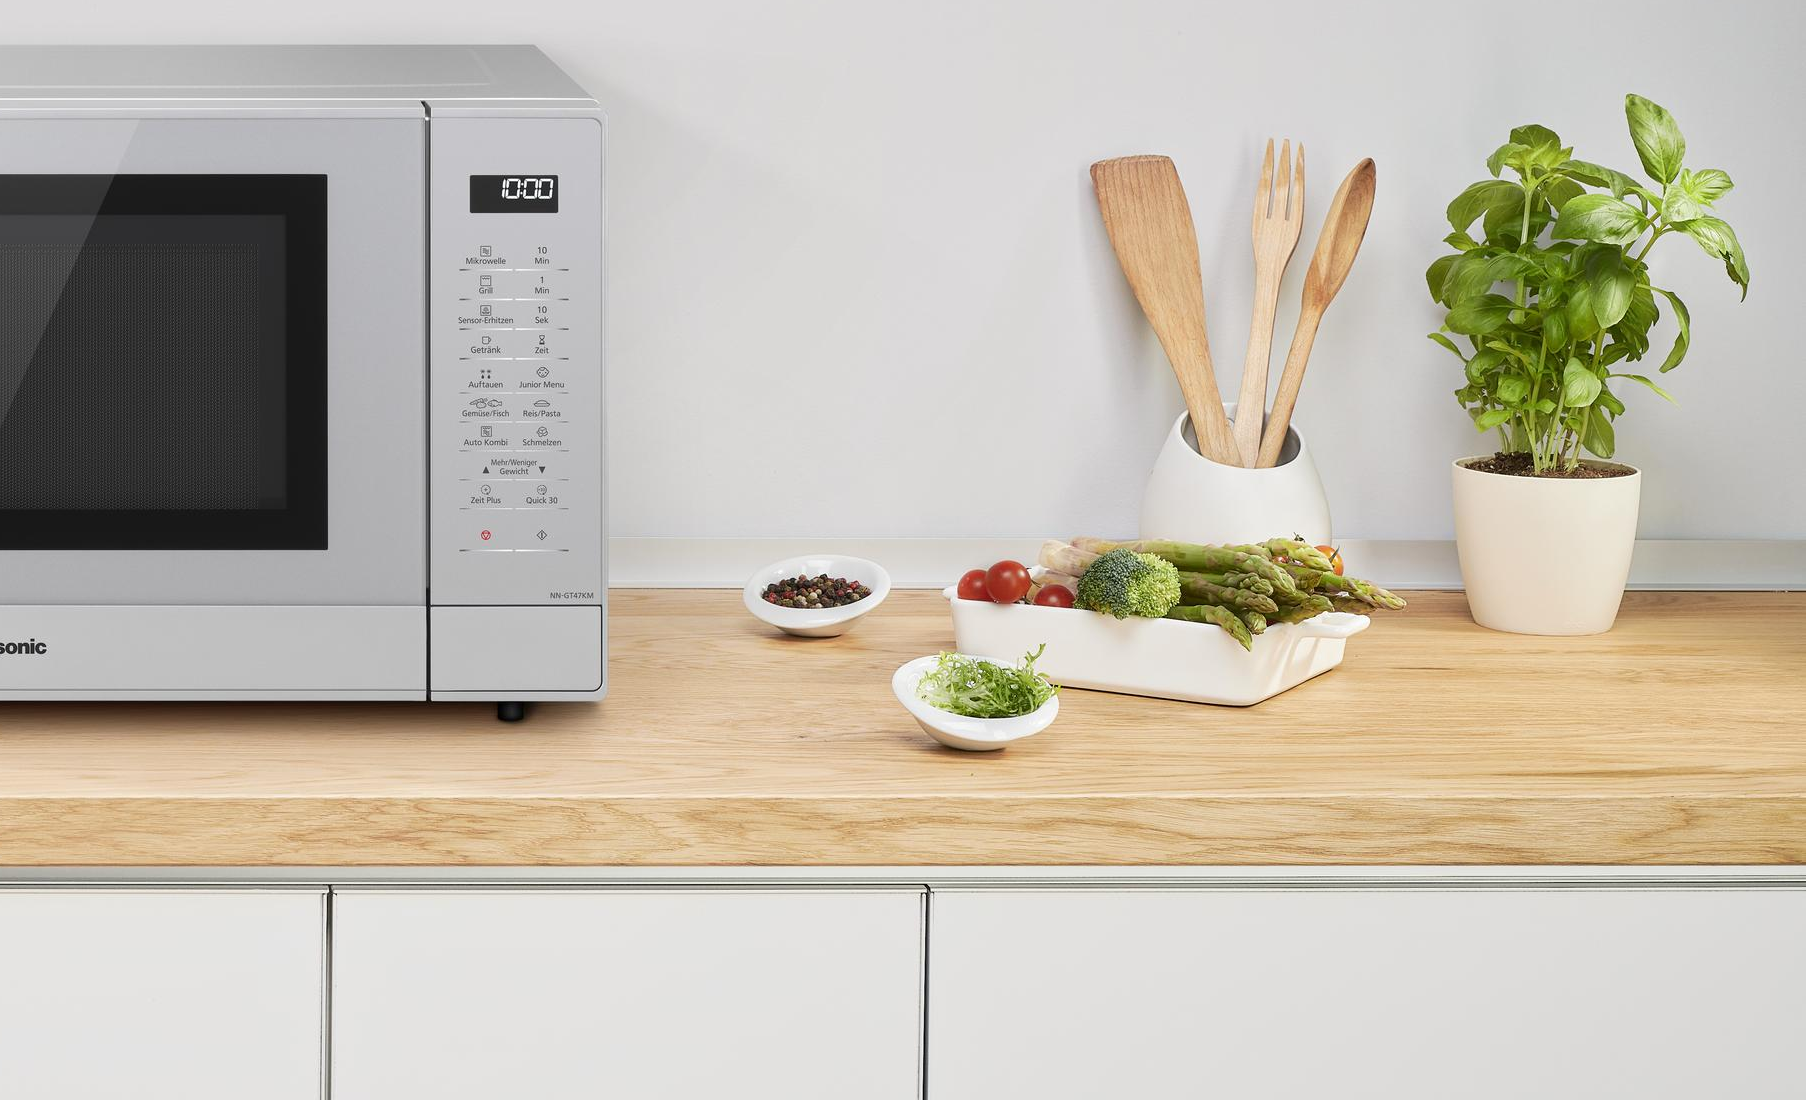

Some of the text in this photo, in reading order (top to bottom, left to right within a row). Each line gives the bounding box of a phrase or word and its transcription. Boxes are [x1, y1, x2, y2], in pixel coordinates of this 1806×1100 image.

[501, 178, 554, 200] 10:00
[537, 246, 548, 254] 10
[465, 257, 507, 265] Mikrowelle
[534, 257, 550, 265] Min
[478, 287, 494, 295] Grill
[534, 287, 550, 295] Min
[537, 305, 548, 314] 10
[458, 316, 514, 324] Sensor-Erhitzen
[534, 316, 549, 324] Sek
[470, 346, 501, 354] Getränk
[534, 346, 549, 354] Zeit
[467, 380, 504, 389] Auftauen
[518, 380, 565, 389] Junior Menu
[461, 409, 510, 418] Gemüse/Fisch
[522, 409, 561, 418] Reis/Pasta
[463, 438, 508, 447] Auto Kombi
[522, 438, 562, 447] Schmelzen
[490, 458, 538, 468] Mehr/Weniger
[499, 467, 529, 476] Gewicht
[470, 496, 502, 504] Zeit Plus
[526, 496, 558, 505] Quick 30
[549, 591, 594, 599] NN-GT47KM
